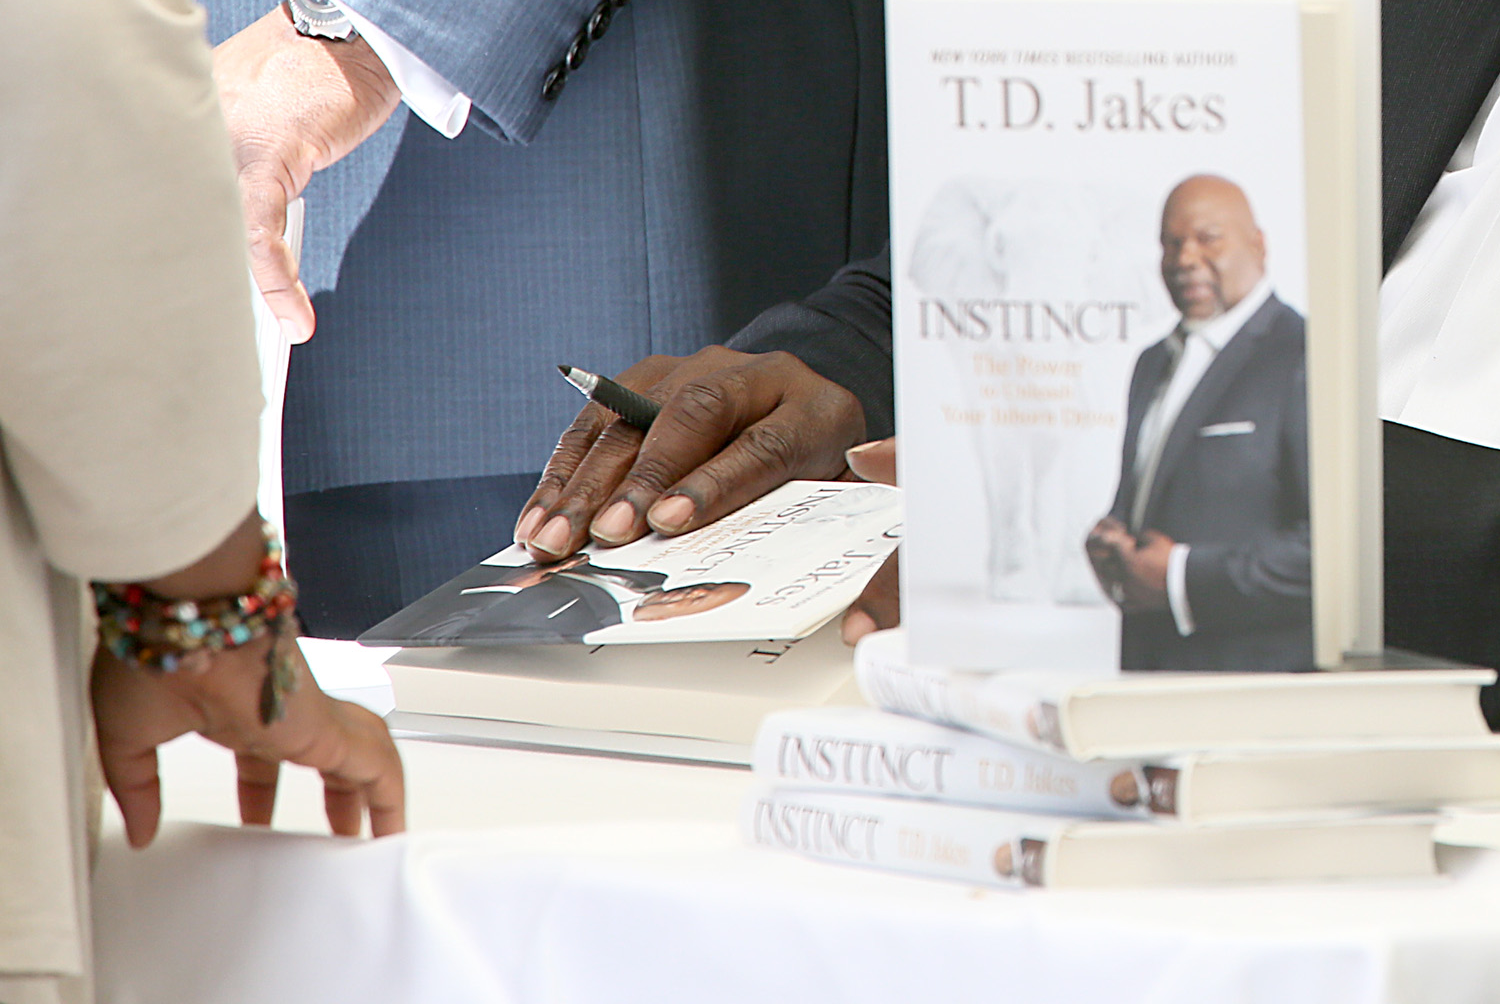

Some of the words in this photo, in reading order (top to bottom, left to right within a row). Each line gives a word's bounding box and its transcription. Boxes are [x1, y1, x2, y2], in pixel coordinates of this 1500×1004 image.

[941, 75, 1054, 130] T.D.
[1076, 77, 1227, 132] Jakes
[919, 299, 1139, 343] INSTINCT
[972, 352, 1011, 377] The
[686, 488, 849, 575] INSTINCT
[756, 550, 878, 607] Jakes
[777, 734, 955, 793] INSTINCT
[754, 799, 882, 861] INSTINCT
